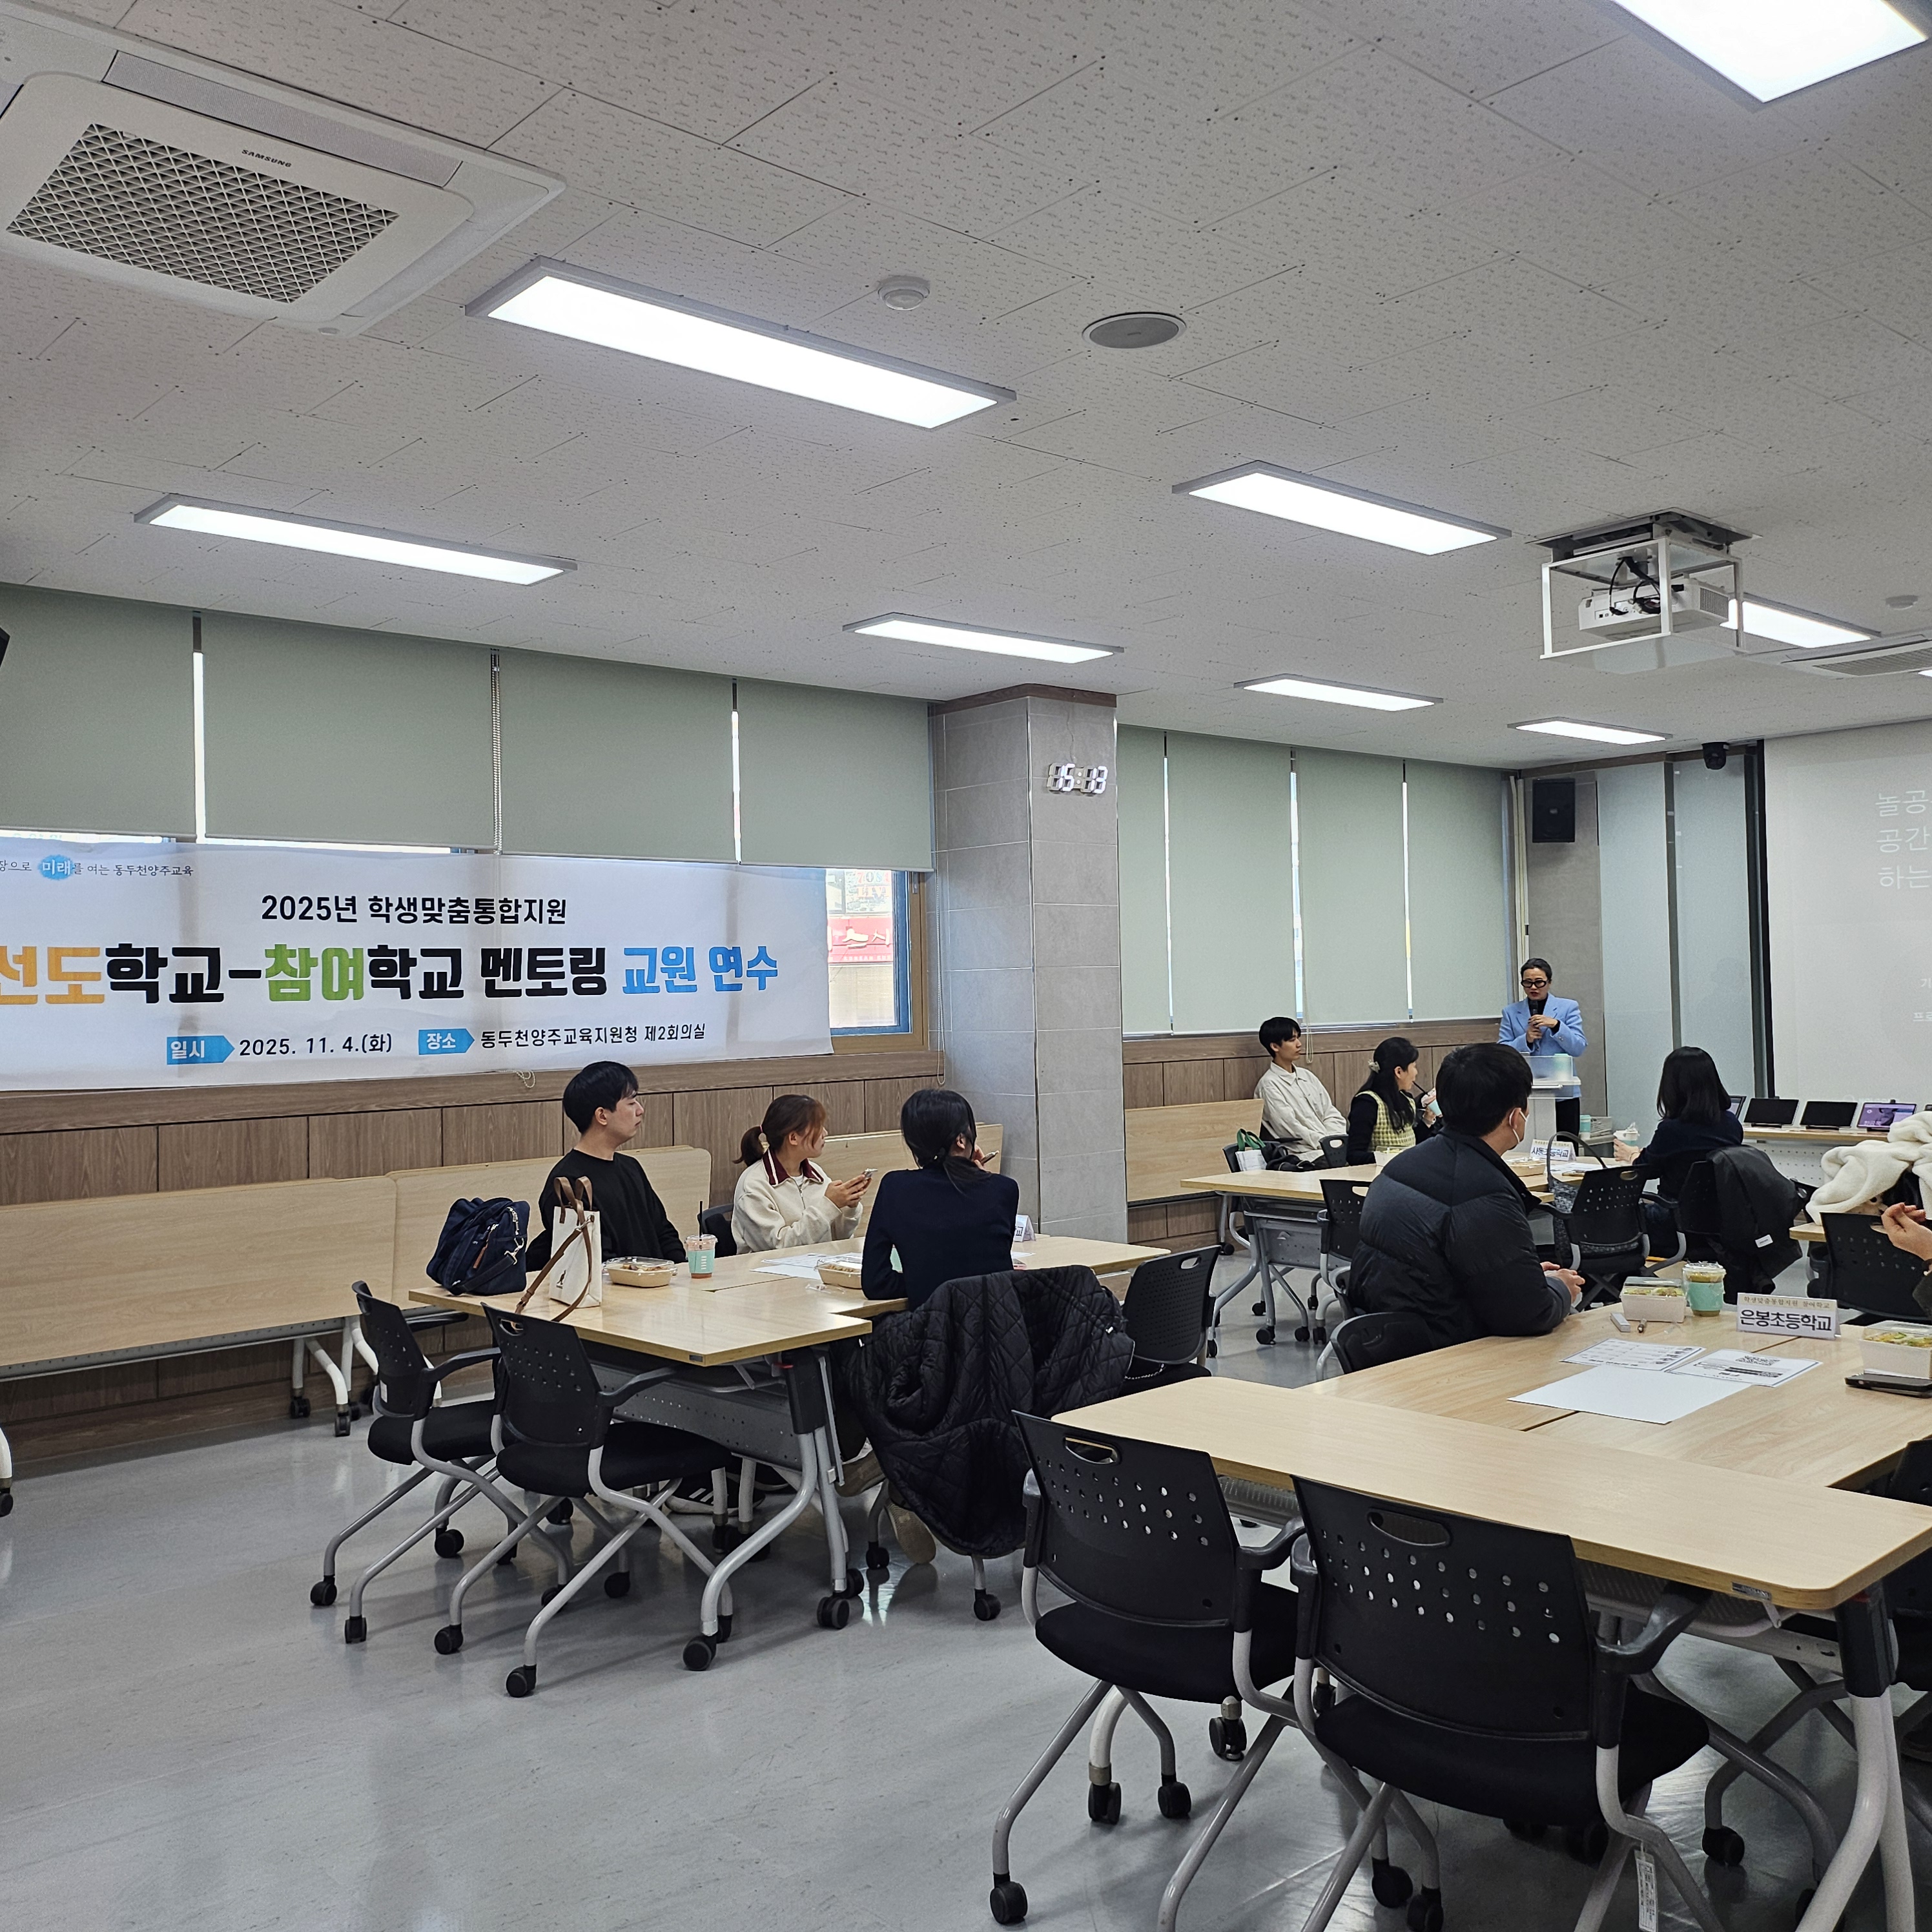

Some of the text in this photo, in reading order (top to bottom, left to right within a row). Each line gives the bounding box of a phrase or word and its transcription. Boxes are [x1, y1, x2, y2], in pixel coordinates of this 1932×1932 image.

[242, 149, 292, 167] SAMSUNG
[1875, 790, 1932, 817] 놀공
[1876, 826, 1931, 853] 공간
[41, 859, 83, 875] 미래를
[87, 865, 110, 876] 여는
[113, 865, 194, 876] 동두천양주교육
[1878, 865, 1932, 889] 하는
[261, 895, 566, 925] 2025년 학생맞춤통합지원
[480, 947, 607, 998] 멘토링
[622, 946, 698, 994] 교원
[708, 946, 778, 992] 연수
[170, 1023, 706, 1059] 일시 2025. 11. 4.(화) 장소 동두천양주교육지원청 제2회의실
[1740, 1310, 1832, 1331] 은봉초등학교
